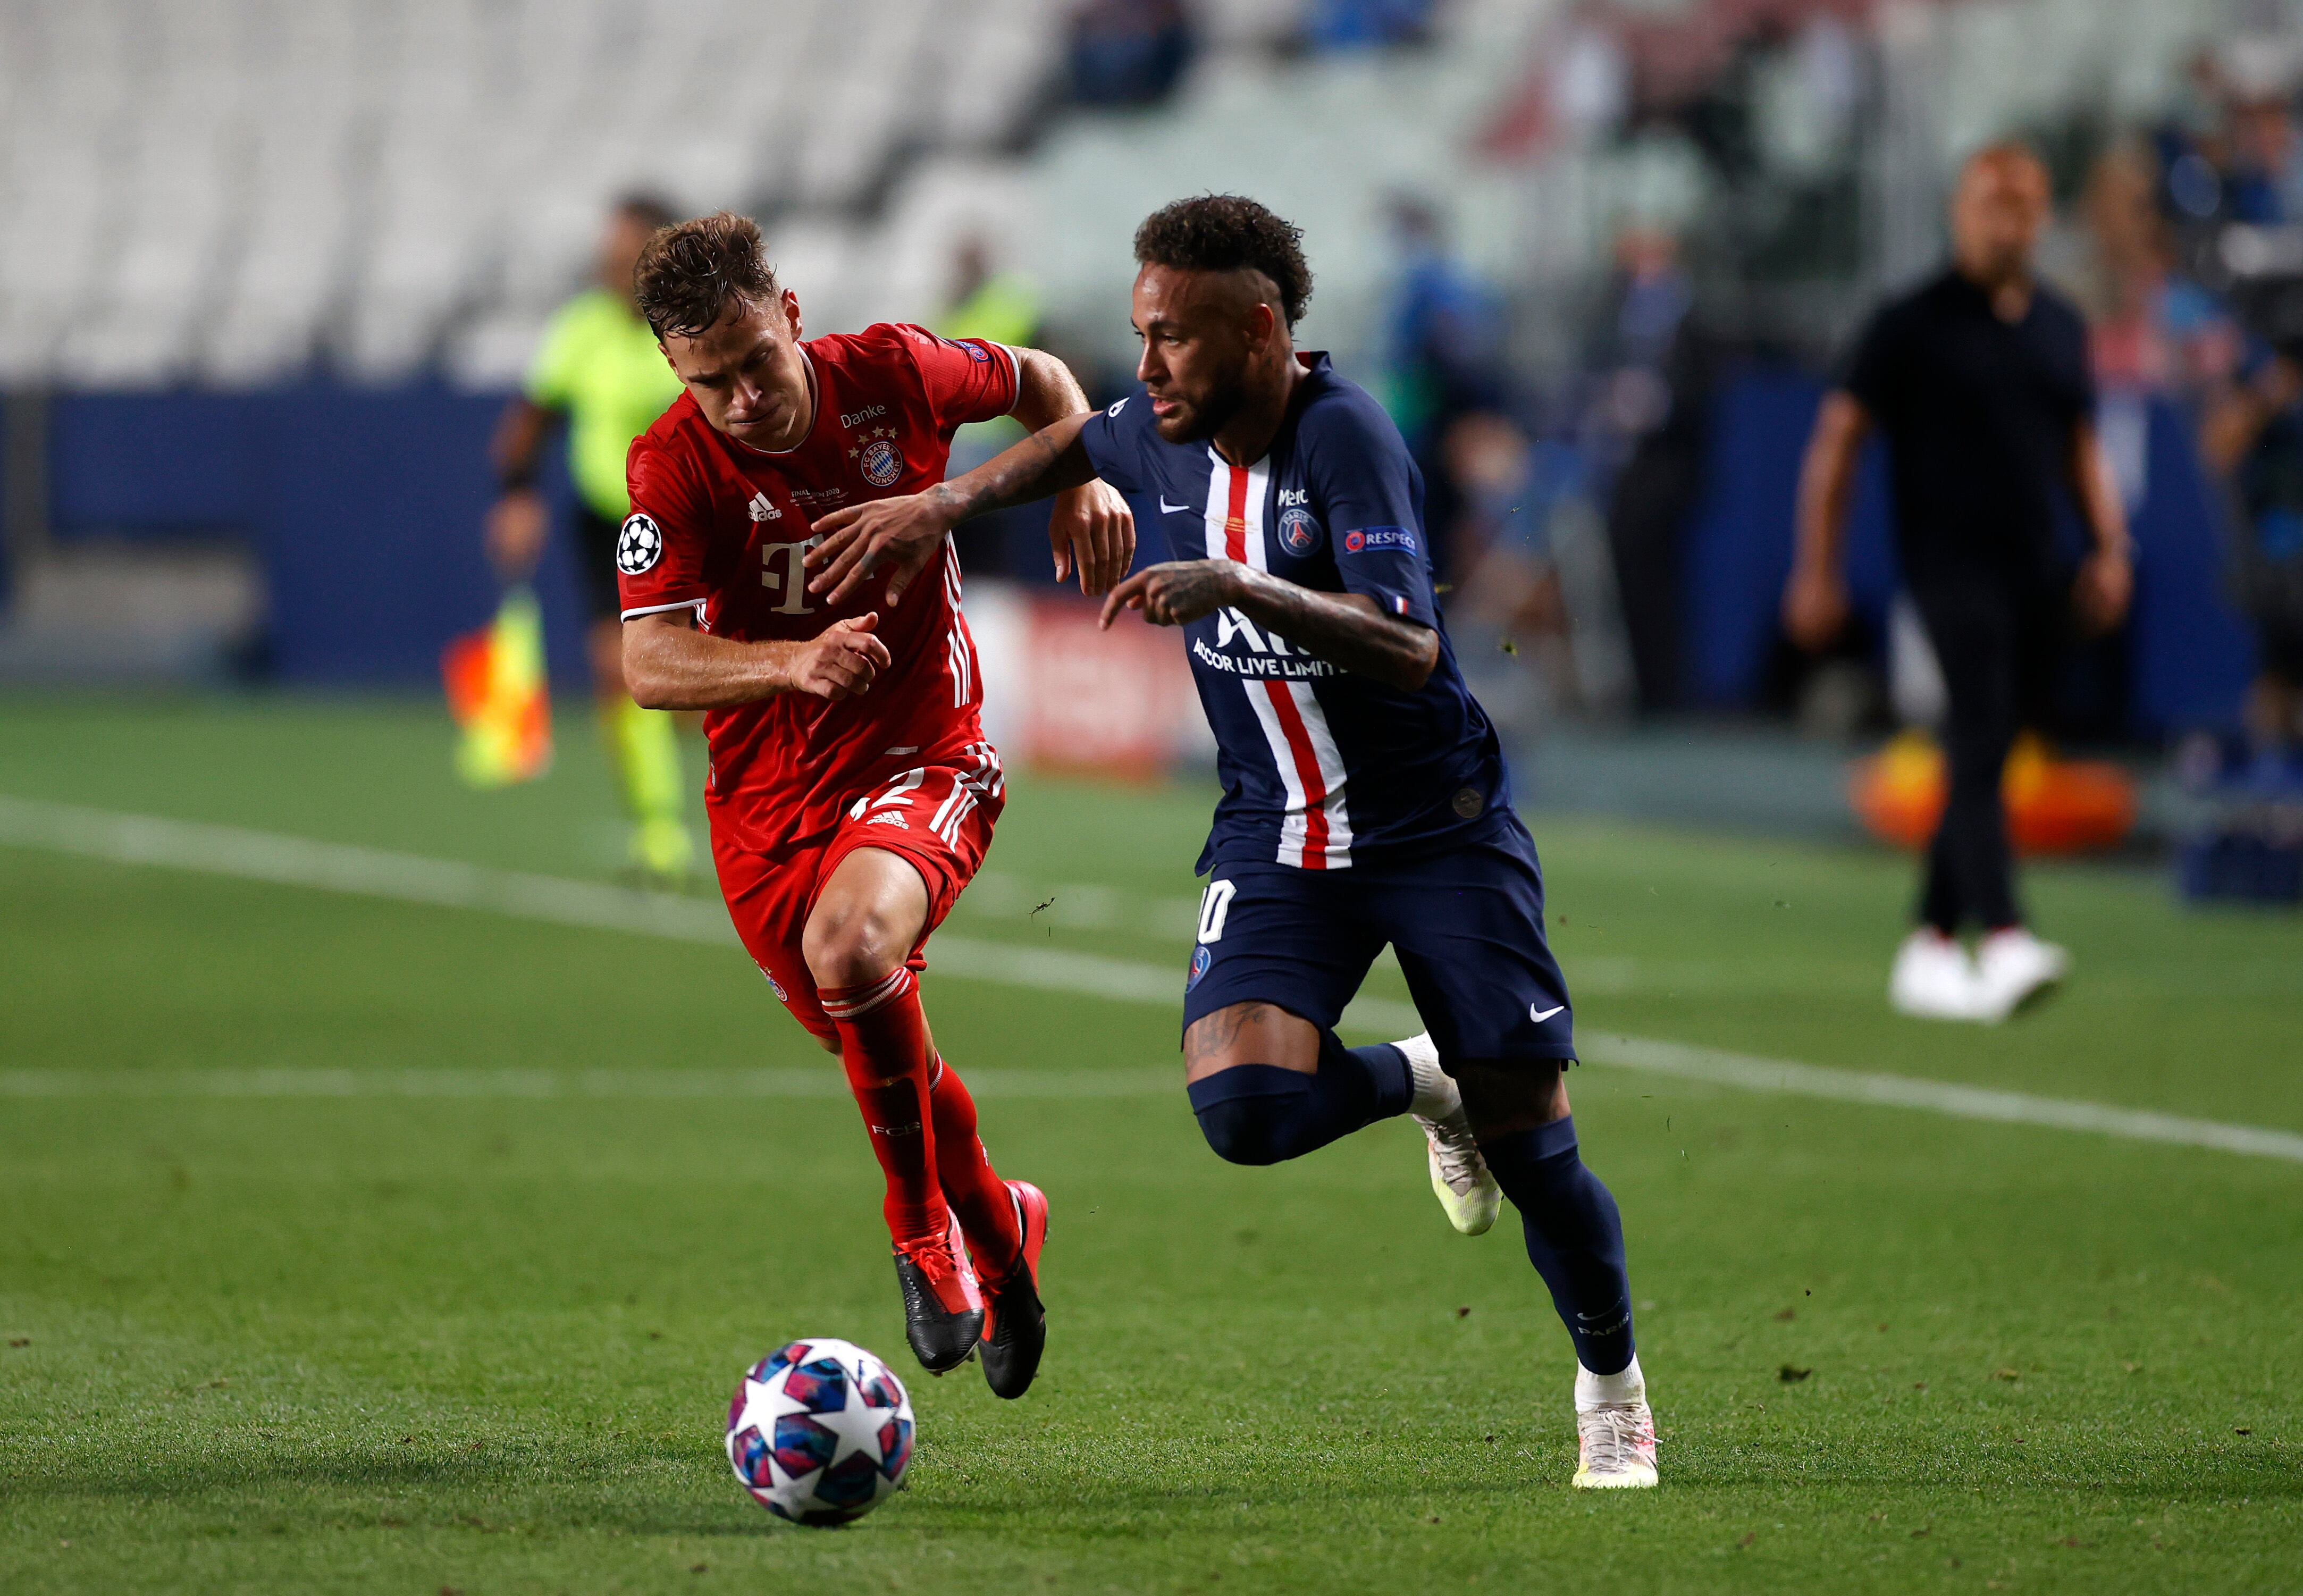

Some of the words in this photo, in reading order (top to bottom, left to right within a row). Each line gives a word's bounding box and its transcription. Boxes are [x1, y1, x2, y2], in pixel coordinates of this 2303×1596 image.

[840, 405, 887, 429] Danke
[863, 456, 870, 468] FC
[868, 443, 896, 456] BAYERN
[791, 489, 811, 498] FINAL
[825, 488, 840, 497] 2020
[1193, 637, 1236, 673] ACCOR
[1237, 657, 1281, 675] LIVE
[866, 816, 910, 830] adidas
[1197, 879, 1238, 945] 0
